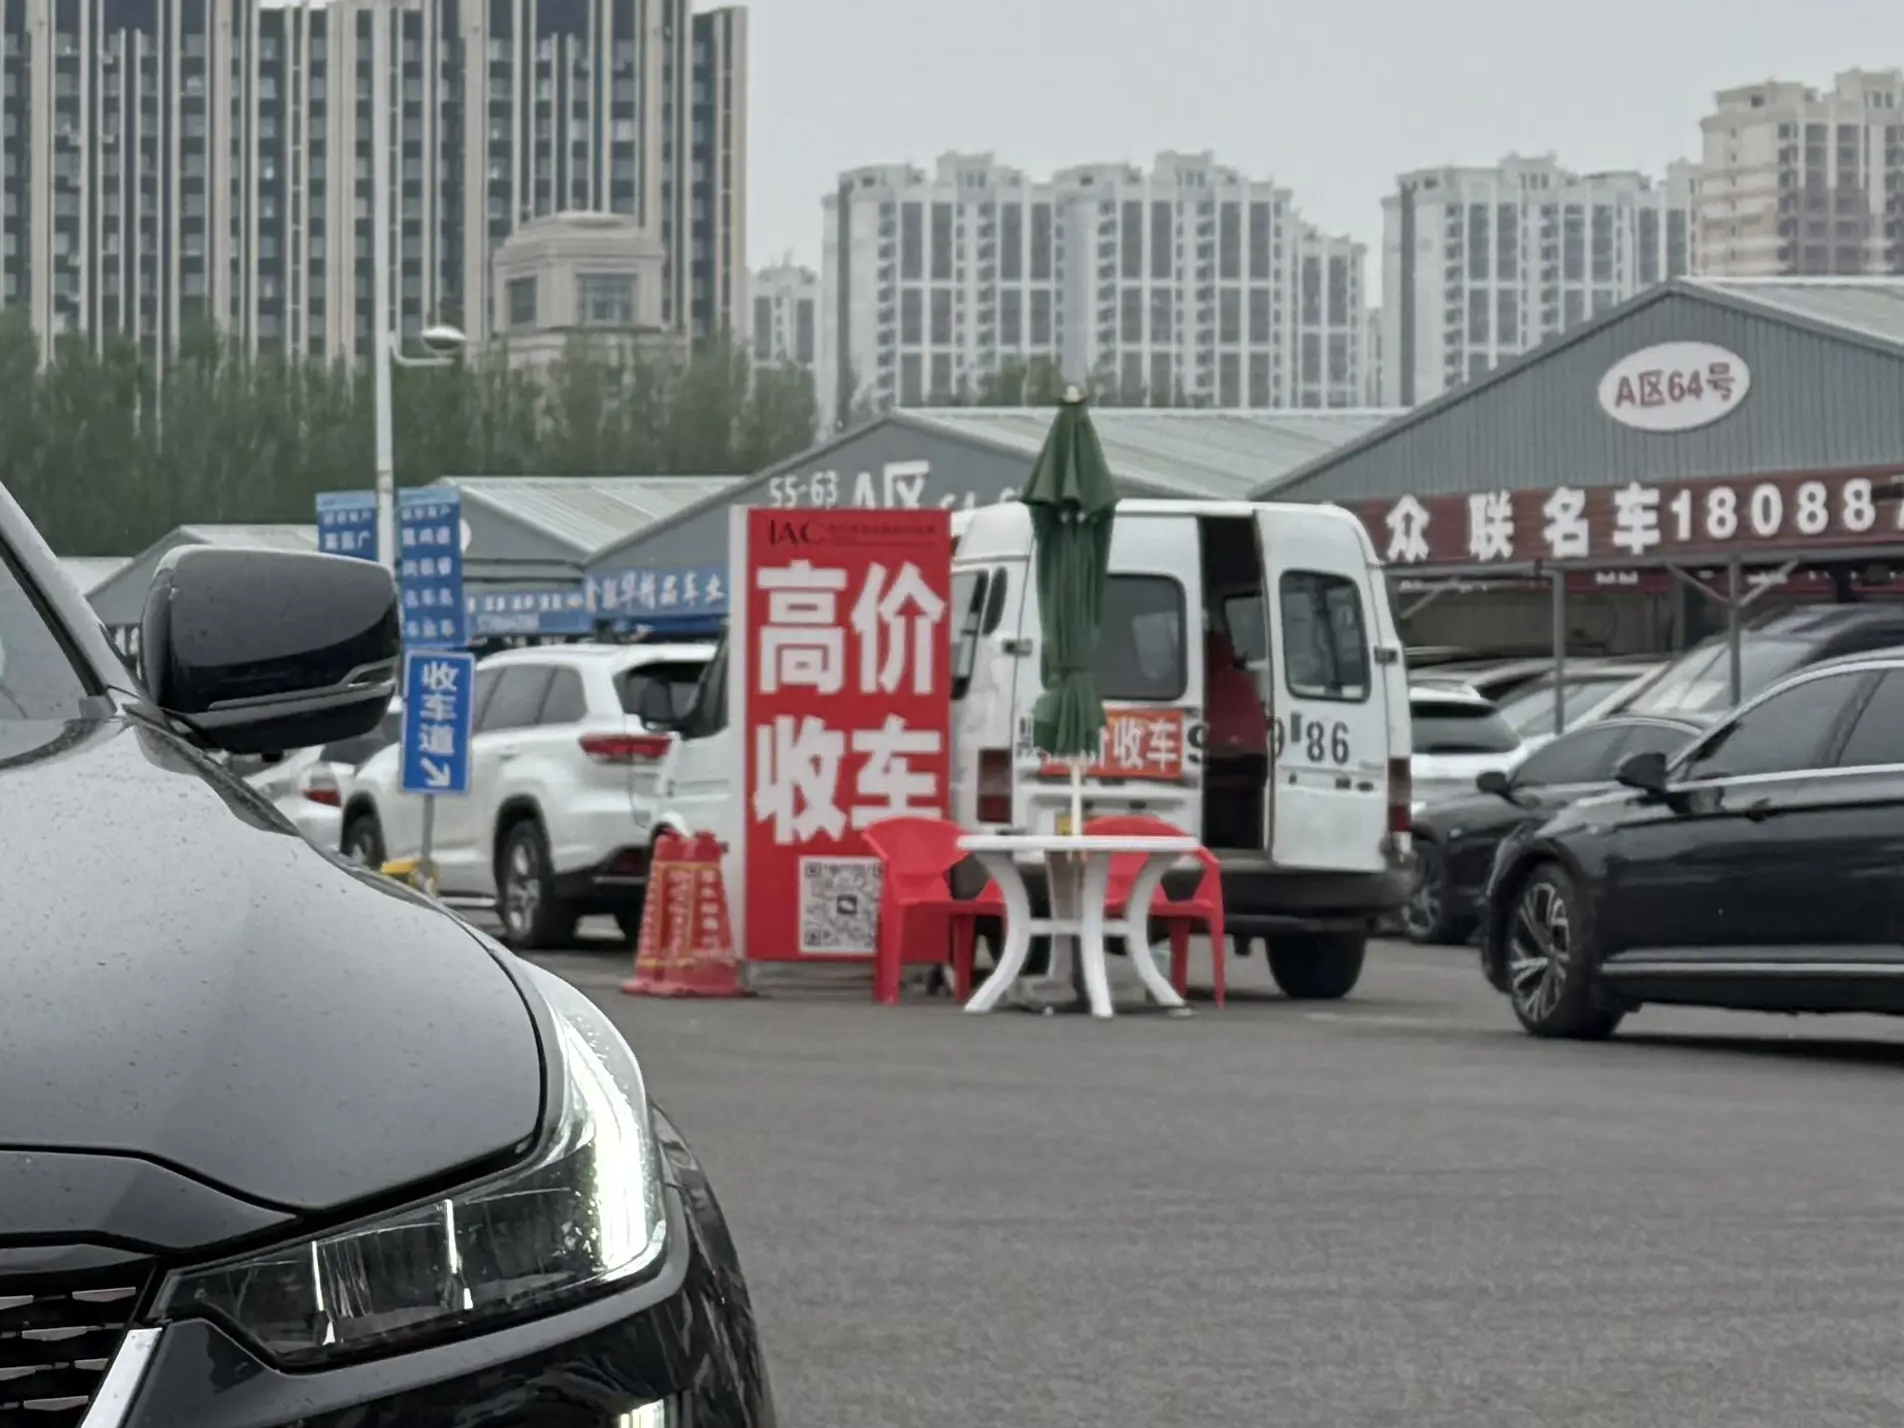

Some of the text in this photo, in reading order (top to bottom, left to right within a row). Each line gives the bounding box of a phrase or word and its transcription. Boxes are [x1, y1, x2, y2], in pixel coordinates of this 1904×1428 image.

[1615, 362, 1736, 408] A区64号
[757, 560, 945, 696] 高价
[418, 660, 460, 755] 收车道
[1097, 716, 1179, 774] 收车
[753, 715, 942, 845] 收车
